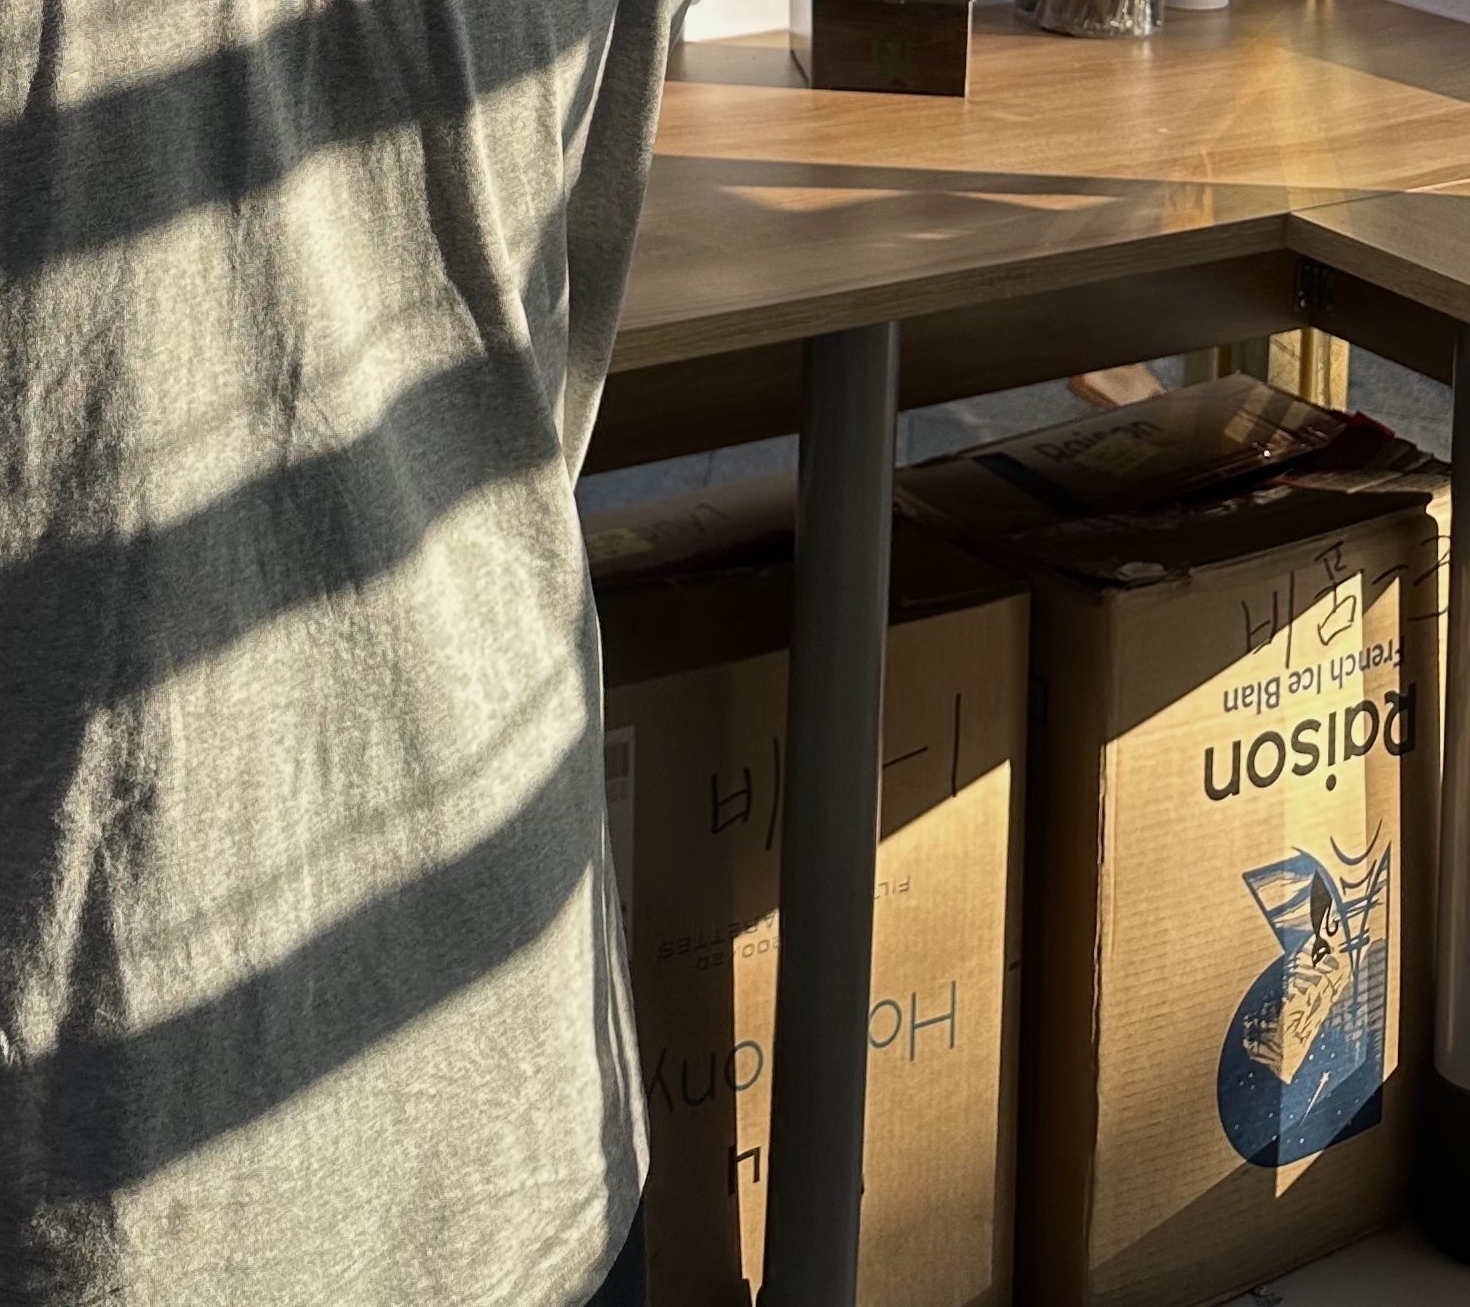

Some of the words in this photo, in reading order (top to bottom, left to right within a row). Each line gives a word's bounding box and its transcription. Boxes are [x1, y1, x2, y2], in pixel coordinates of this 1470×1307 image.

[1223, 675, 1281, 715] Blan
[1288, 663, 1322, 695] Ice
[1203, 681, 1417, 802] Raison
